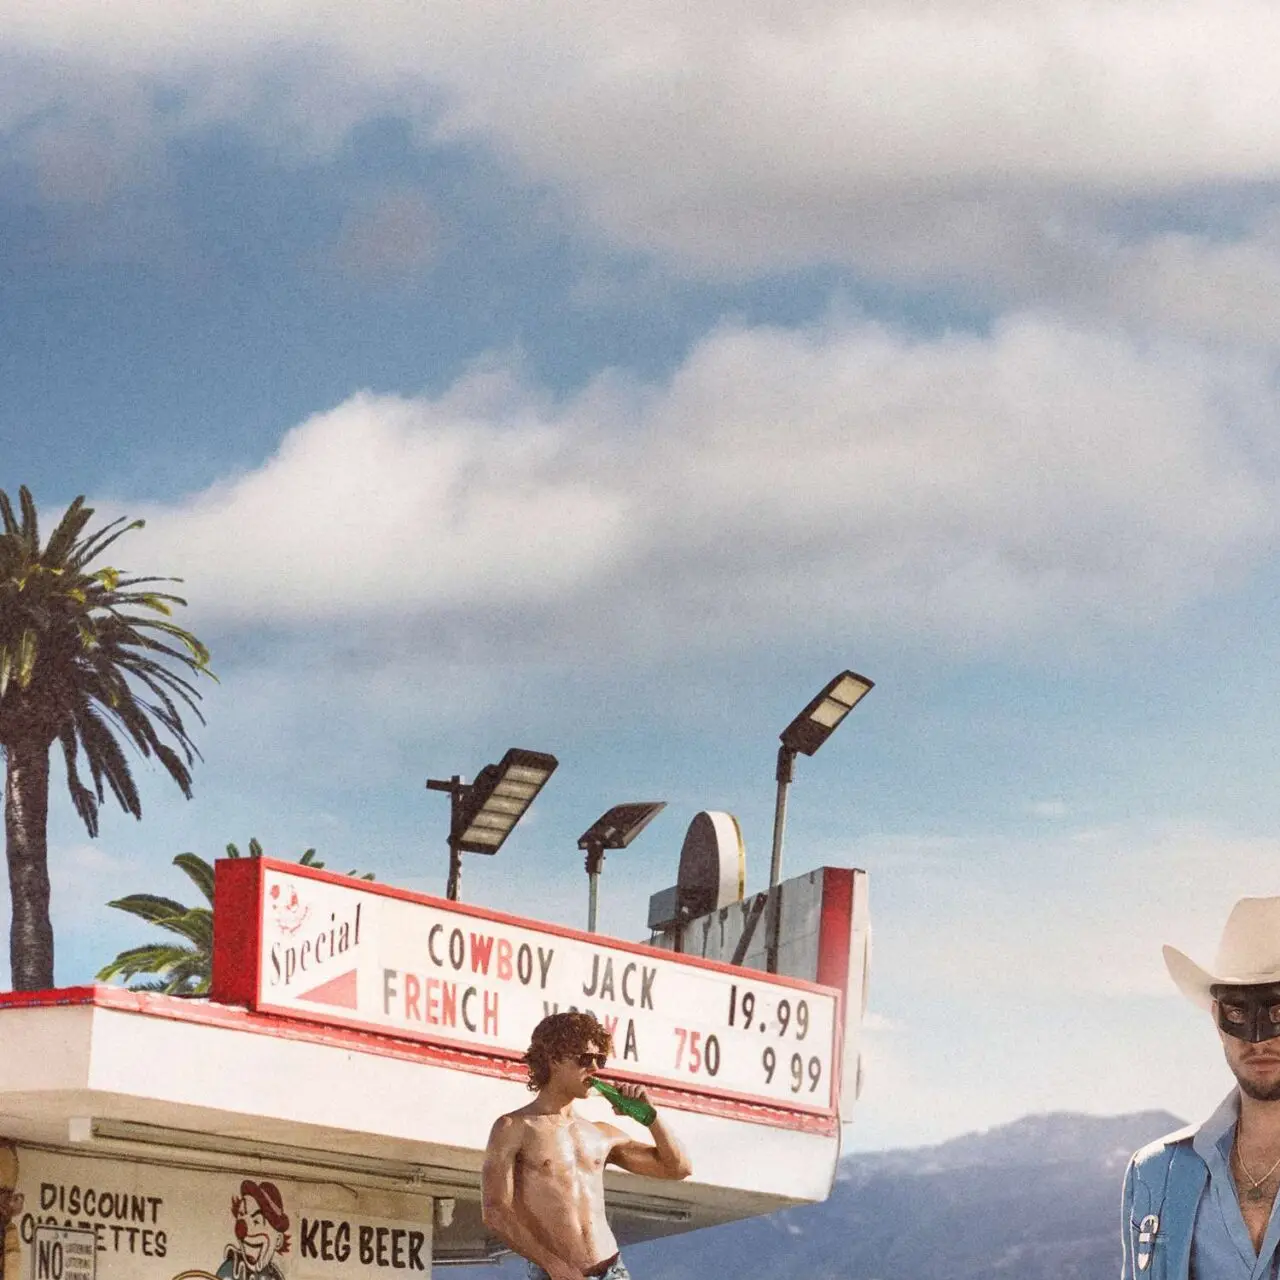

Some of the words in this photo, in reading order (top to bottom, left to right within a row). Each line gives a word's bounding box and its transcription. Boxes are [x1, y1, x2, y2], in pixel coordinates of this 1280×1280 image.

[270, 902, 361, 986] Special
[429, 924, 554, 989] COWBOY
[583, 954, 657, 1010] JACK
[728, 985, 809, 1041] 19.99
[384, 968, 498, 1036] FRENCH
[675, 1027, 720, 1076] 750
[40, 1182, 163, 1224] DISCOUNT
[38, 1240, 63, 1280] NO
[301, 1218, 351, 1262] KEG
[359, 1225, 425, 1271] BEER
